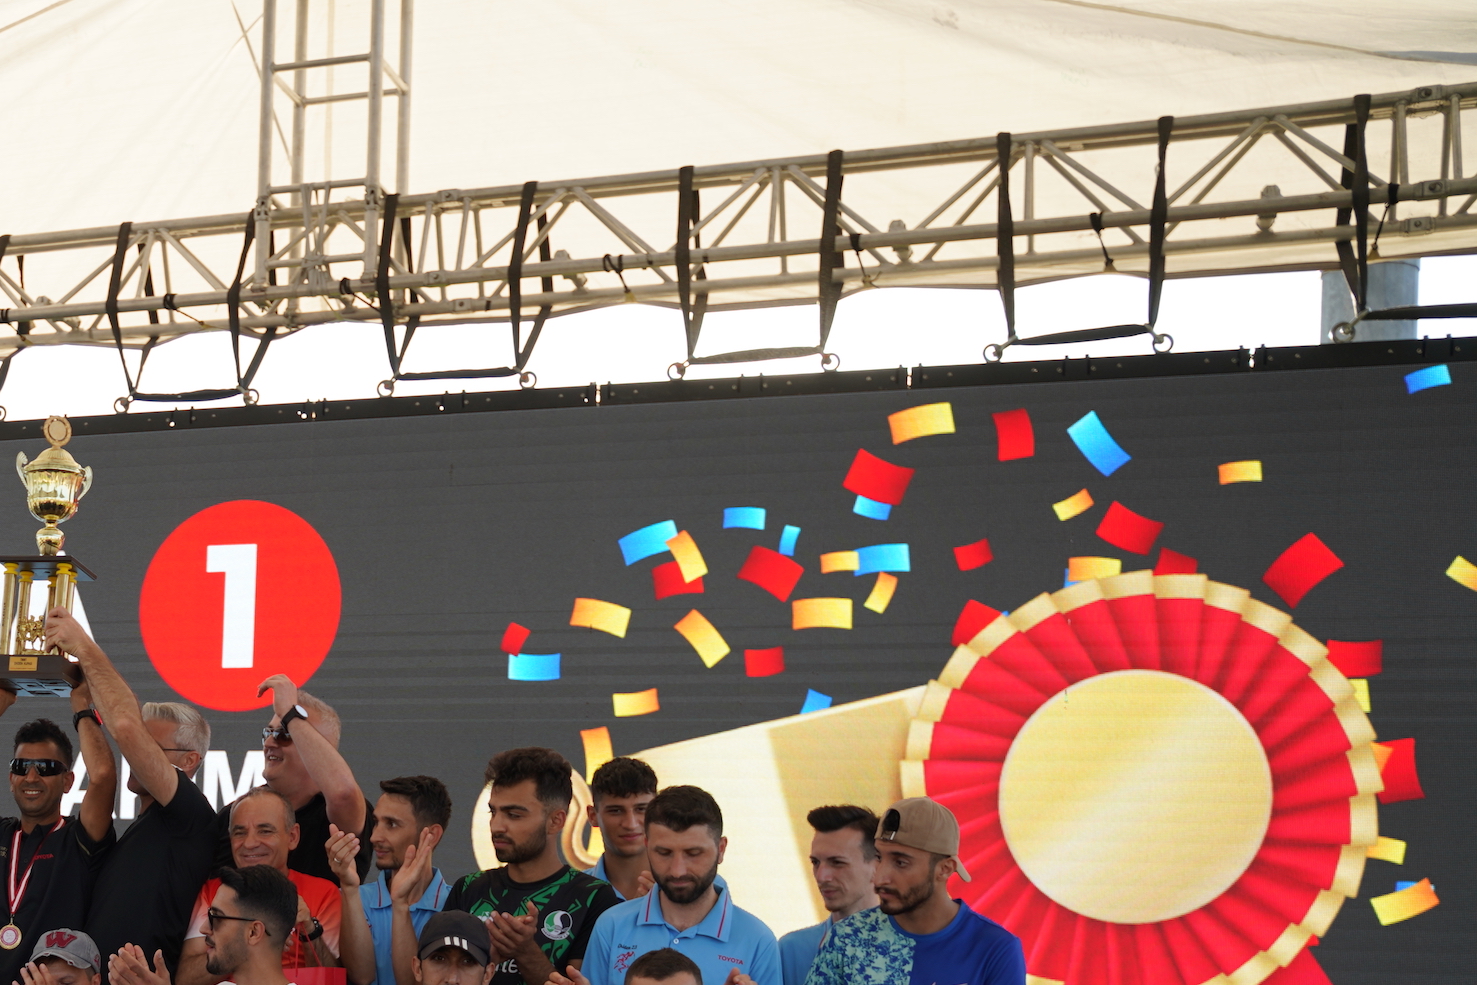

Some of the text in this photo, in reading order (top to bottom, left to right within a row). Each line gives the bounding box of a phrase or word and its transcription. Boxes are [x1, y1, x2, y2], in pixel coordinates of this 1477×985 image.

[207, 544, 258, 669] 1
[45, 931, 78, 948] W
[717, 954, 745, 965] TOYOTA
